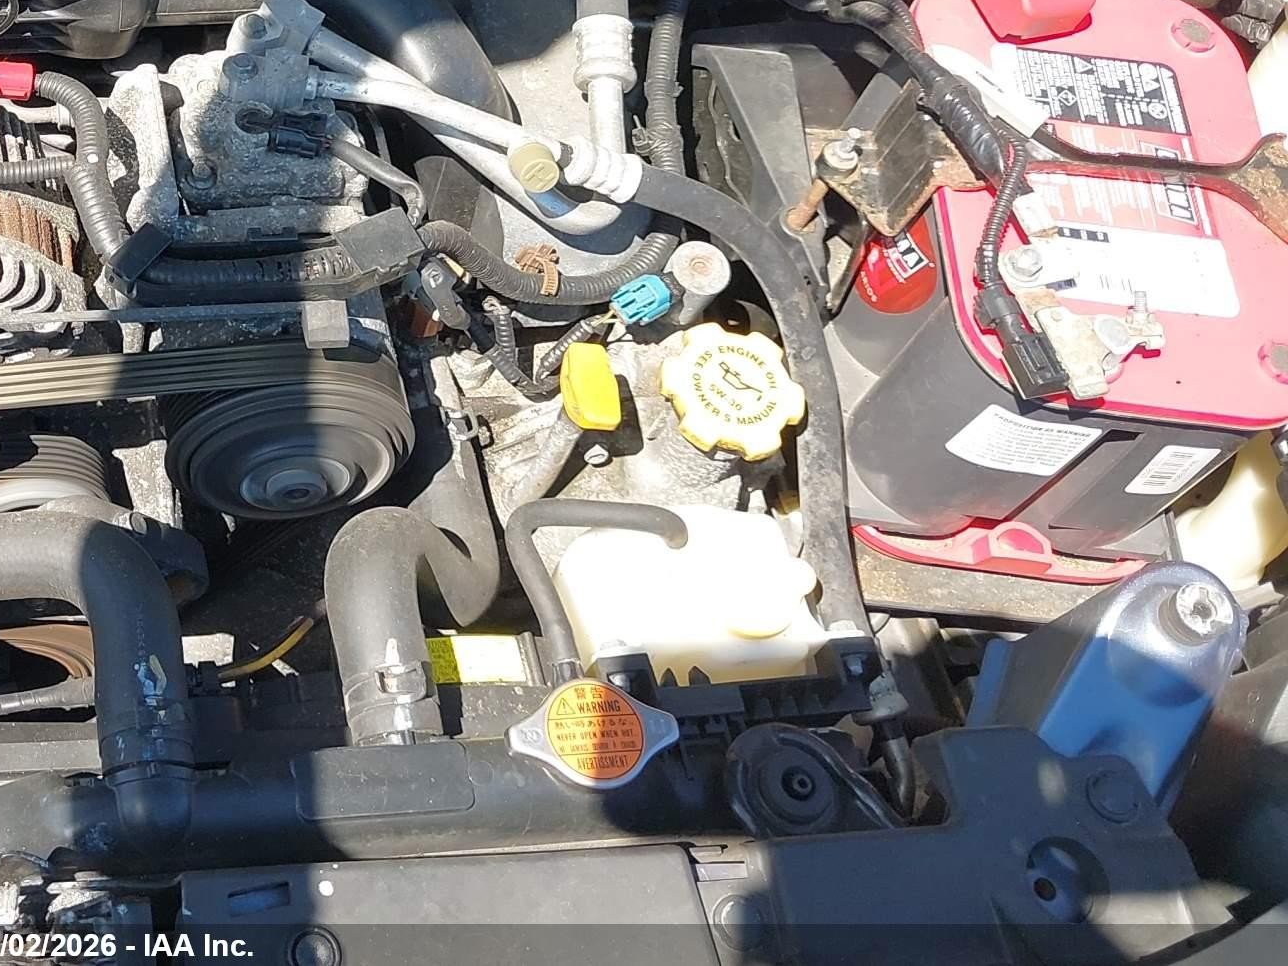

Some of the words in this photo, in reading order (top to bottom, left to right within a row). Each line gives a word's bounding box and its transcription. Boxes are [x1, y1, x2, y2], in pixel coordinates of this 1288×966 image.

[694, 350, 713, 369] SEE
[718, 345, 766, 368] ENGINE
[765, 371, 777, 389] OIL
[692, 373, 731, 422] OWNERS
[736, 401, 777, 426] MANUAL
[577, 700, 621, 714] WARNING
[557, 733, 577, 741] NEVER
[580, 731, 598, 741] OPEN
[600, 729, 618, 739] WHEN
